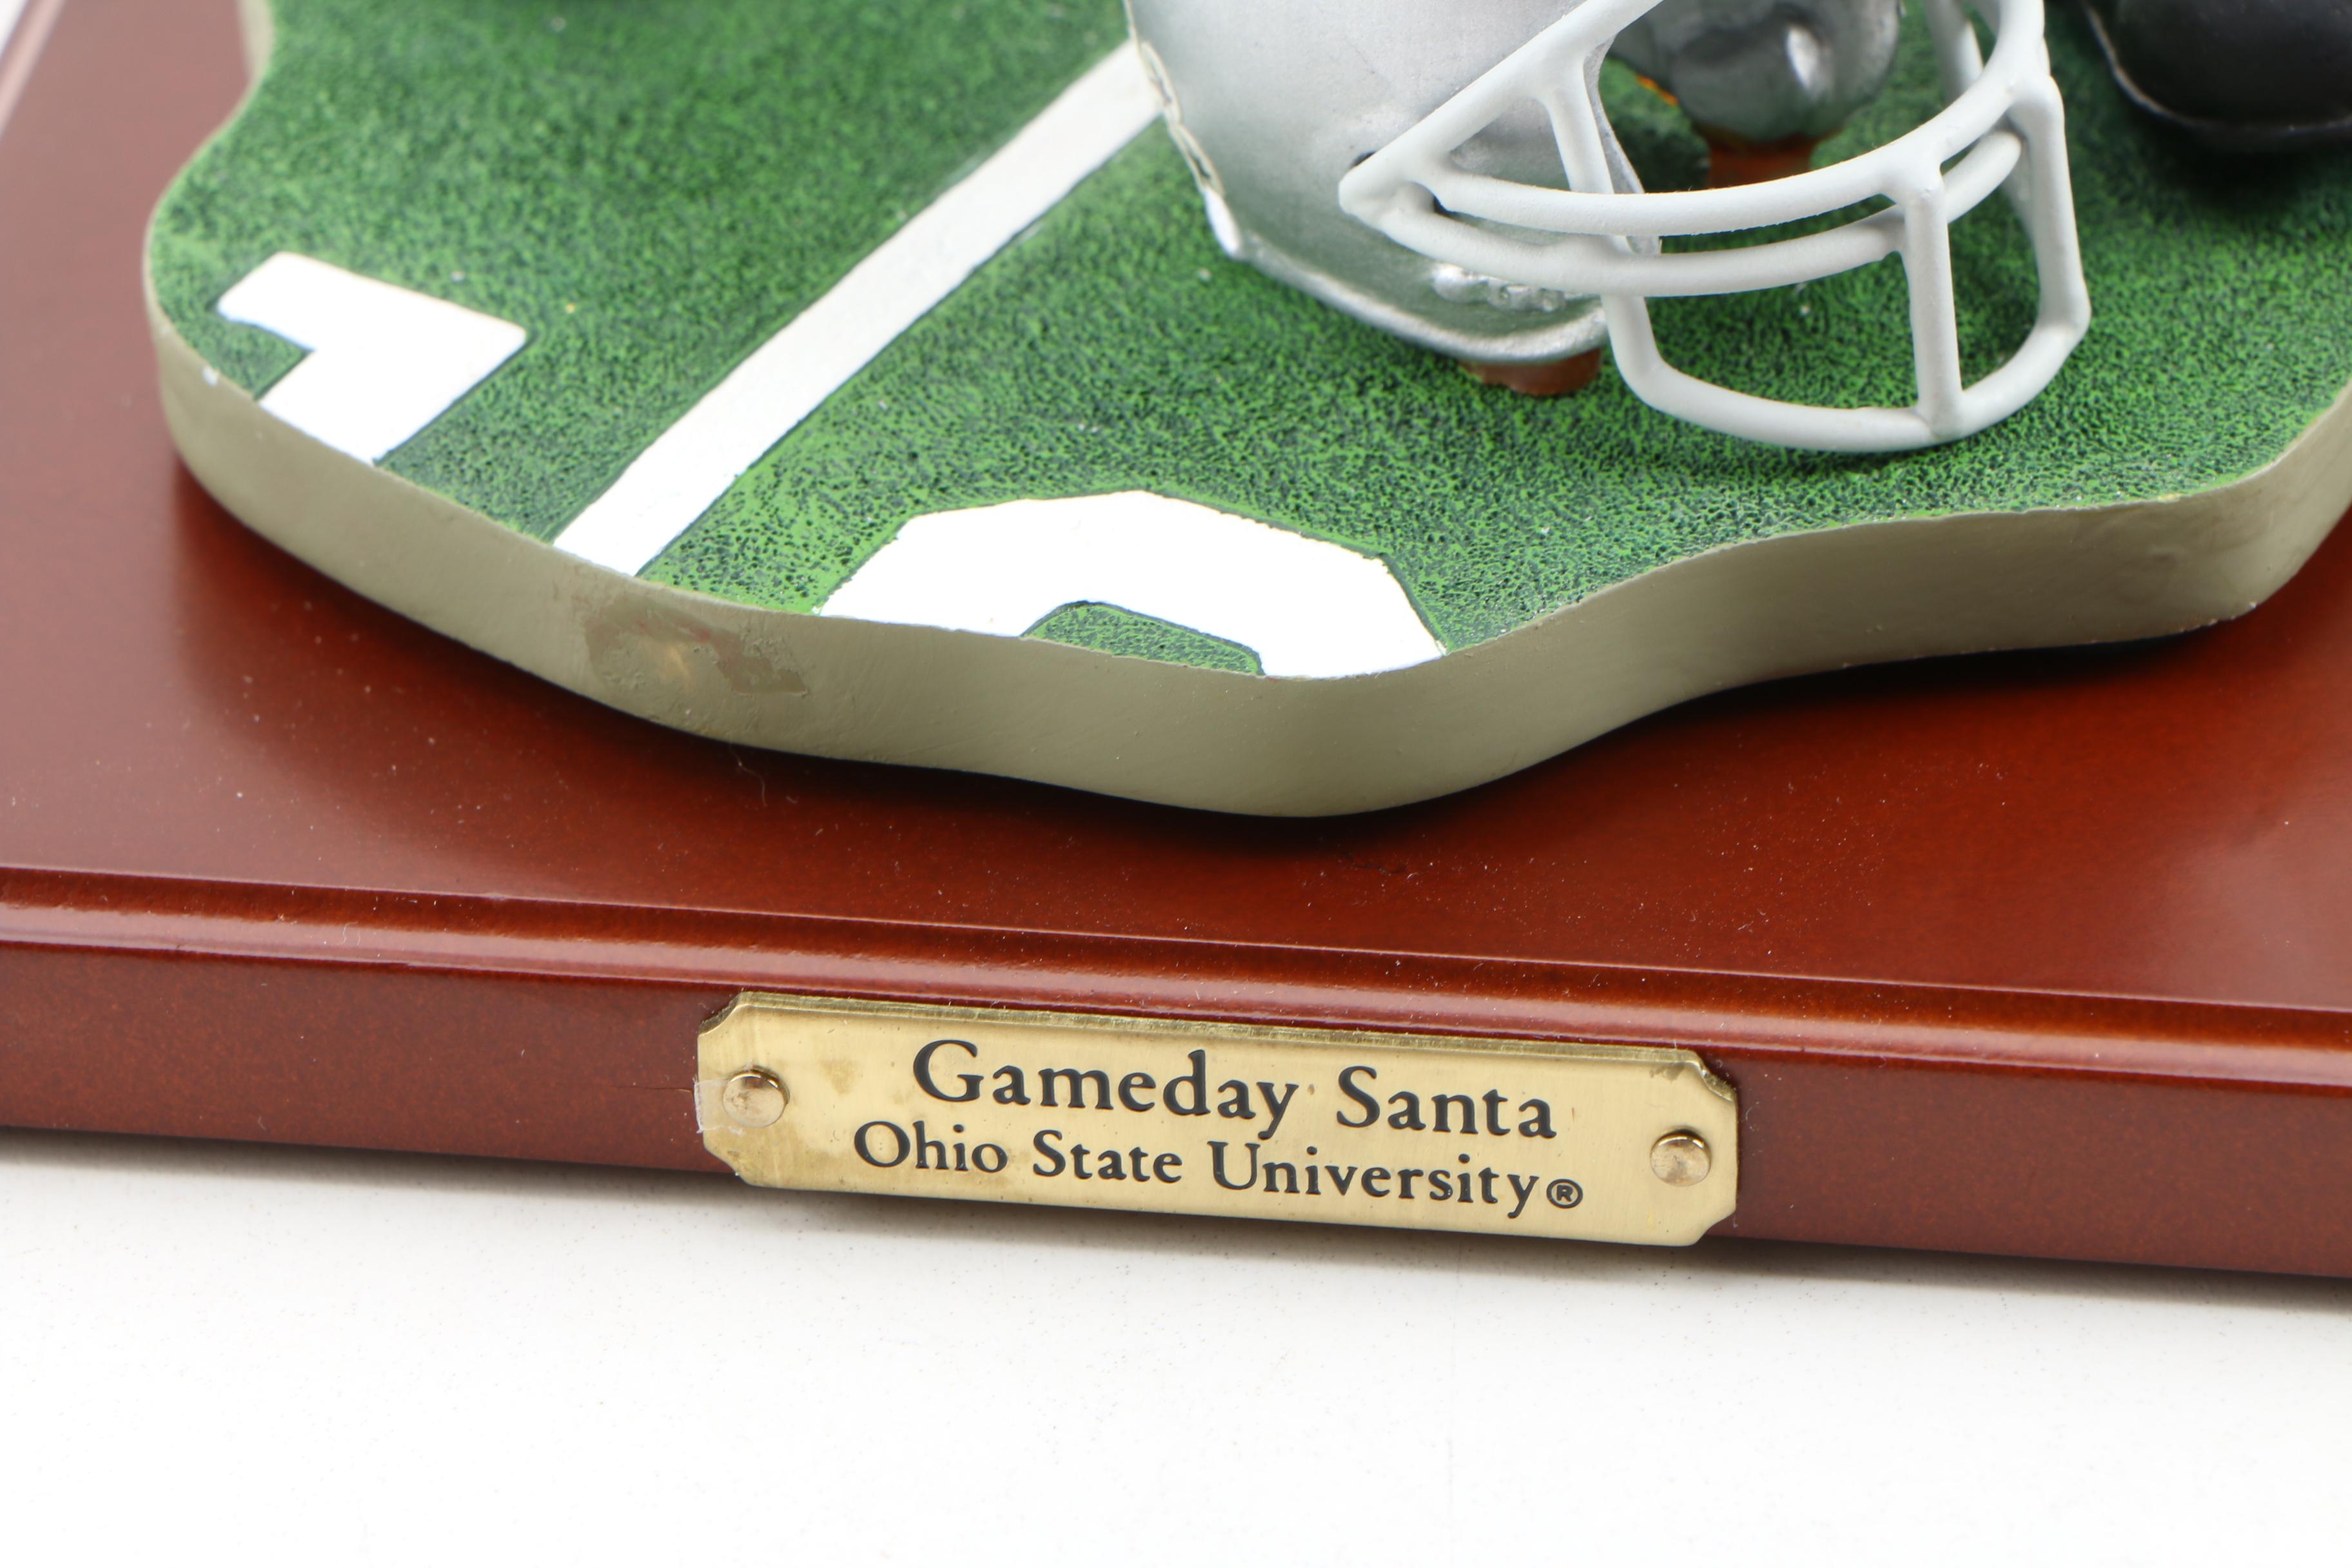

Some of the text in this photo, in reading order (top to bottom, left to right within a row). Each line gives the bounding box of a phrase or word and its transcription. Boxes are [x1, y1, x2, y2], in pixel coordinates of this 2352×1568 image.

[912, 1039, 1557, 1141] Gameday Santa
[853, 1120, 1008, 1174] Ohio
[1032, 1129, 1183, 1184] State
